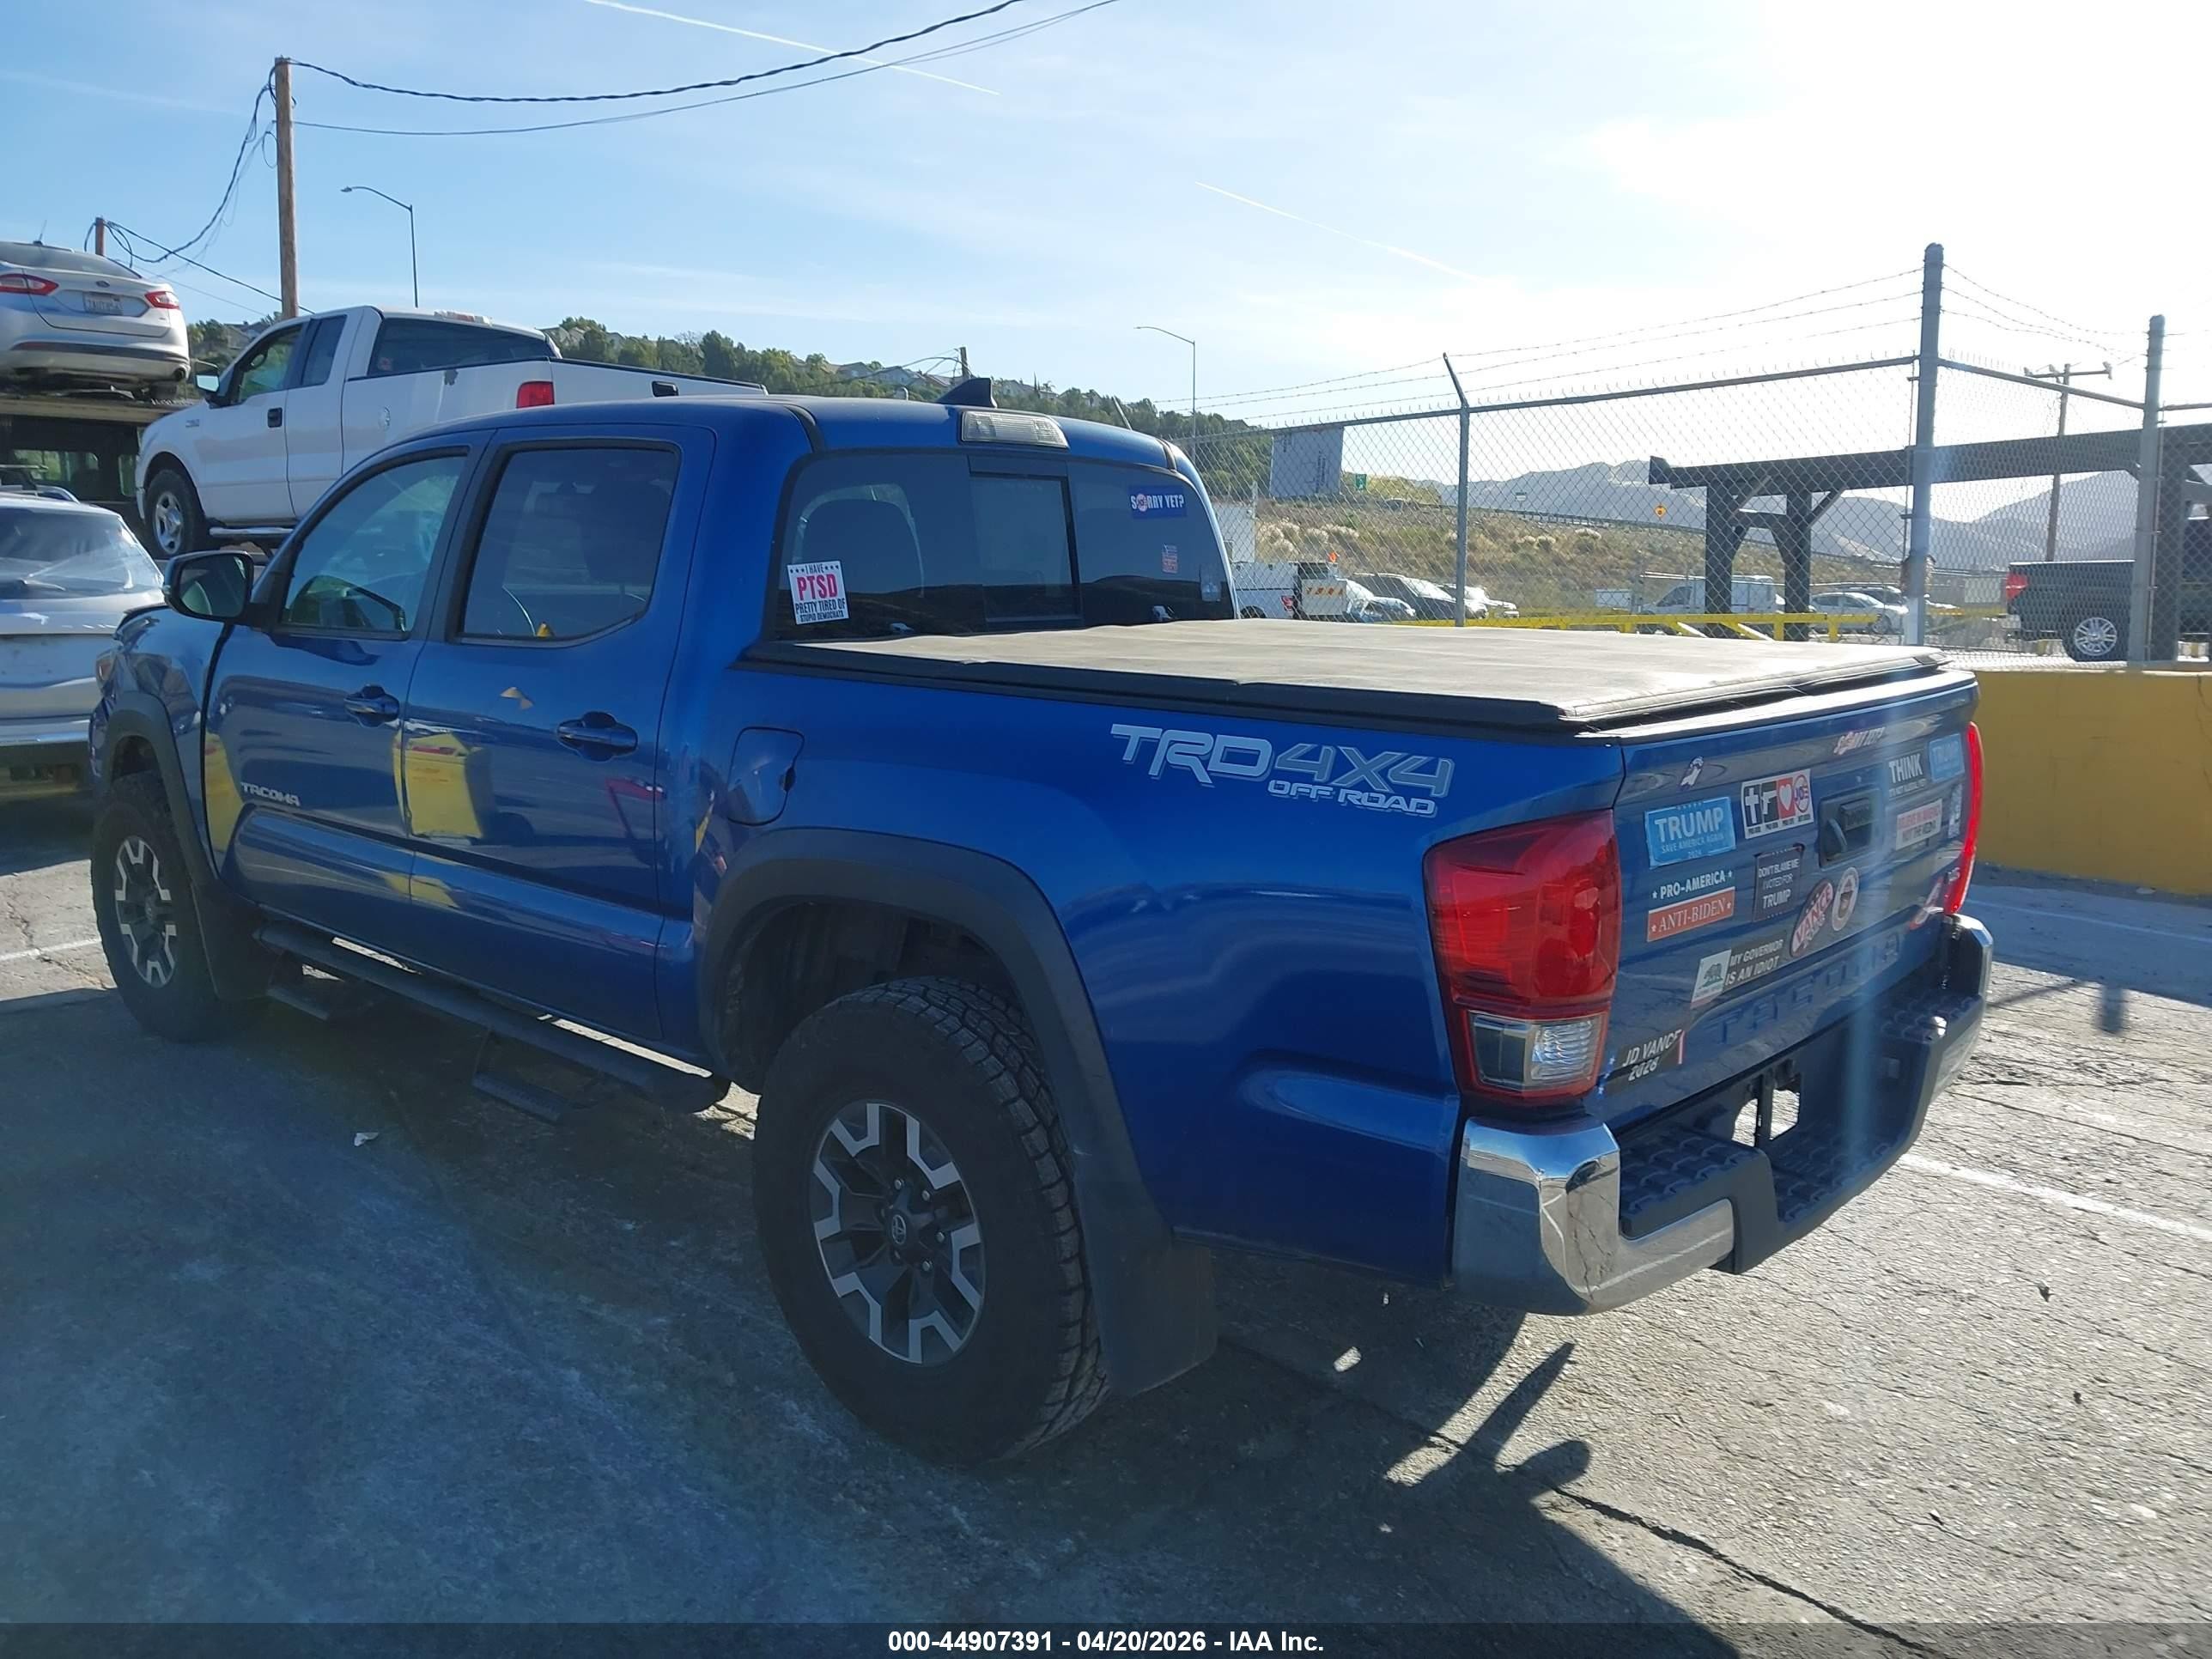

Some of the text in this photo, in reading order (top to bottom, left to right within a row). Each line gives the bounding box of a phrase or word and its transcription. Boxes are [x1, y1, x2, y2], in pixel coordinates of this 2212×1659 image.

[1164, 494, 1184, 507] YET?
[809, 563, 824, 574] HAVE
[797, 574, 837, 600] PTSD
[795, 598, 845, 614] PRETTY TIRED OF
[1111, 724, 1273, 787] TRD
[1889, 753, 1923, 783] THINK
[240, 781, 301, 807] TACOMA
[1268, 779, 1438, 817] OFF ROAD
[1655, 807, 1723, 842] TRUMP
[1660, 870, 1726, 899] PRO-AMERICA
[1763, 889, 1791, 908] TRUMP
[1659, 897, 1727, 933] ANTI-BIDEN
[1729, 939, 1784, 967] MY GOVERNOR
[1725, 956, 1779, 986] IS AN IDIOT
[1622, 1047, 1640, 1066] JD
